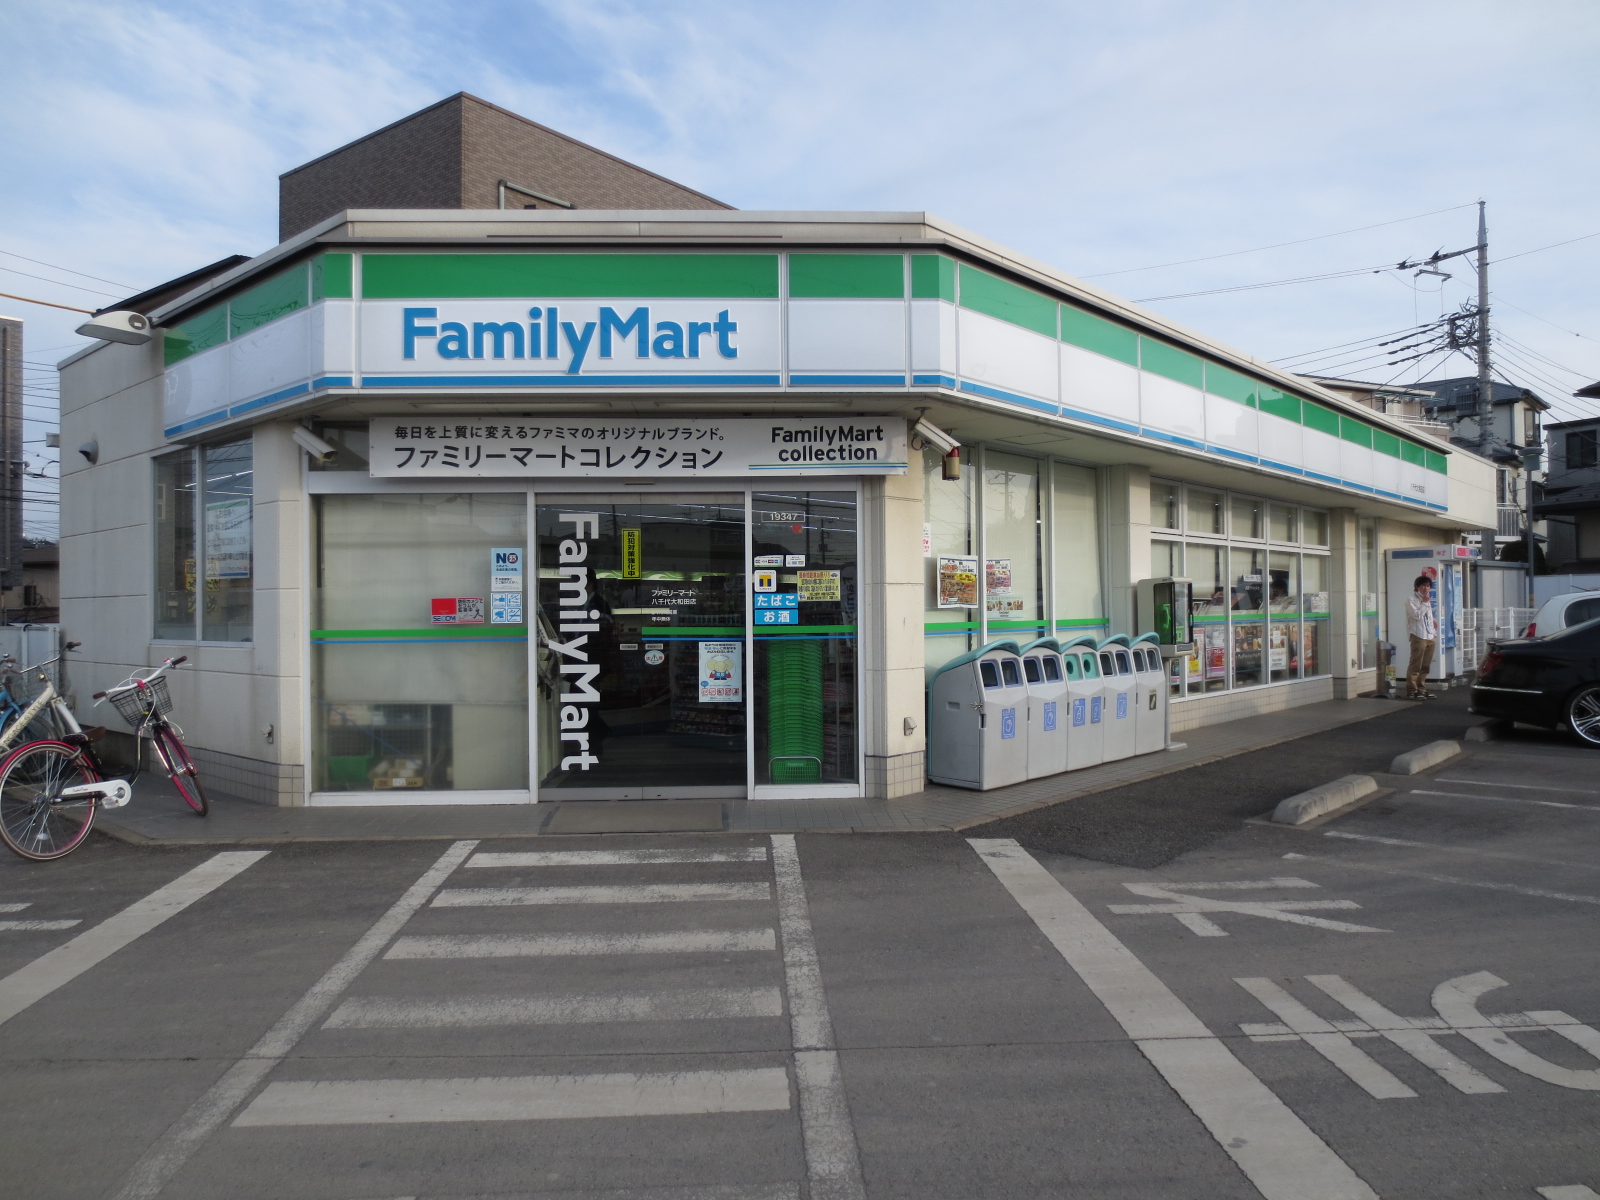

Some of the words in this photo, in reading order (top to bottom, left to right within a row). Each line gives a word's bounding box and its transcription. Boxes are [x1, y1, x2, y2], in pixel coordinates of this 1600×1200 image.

[402, 306, 739, 375] FamilyMart
[394, 425, 725, 441] 毎日を上質に変えるファミマのオリジナルブランド。
[771, 425, 884, 446] FamilyMart
[394, 445, 724, 470] ファミリーマートコレクション
[778, 444, 878, 462] collection
[769, 512, 798, 521] 19347
[627, 531, 636, 577] 防犯対策強化中
[651, 589, 695, 597] ファミリーマート
[757, 595, 796, 606] たばこ
[763, 610, 790, 623] お酒
[548, 513, 601, 771] FamilyMart
